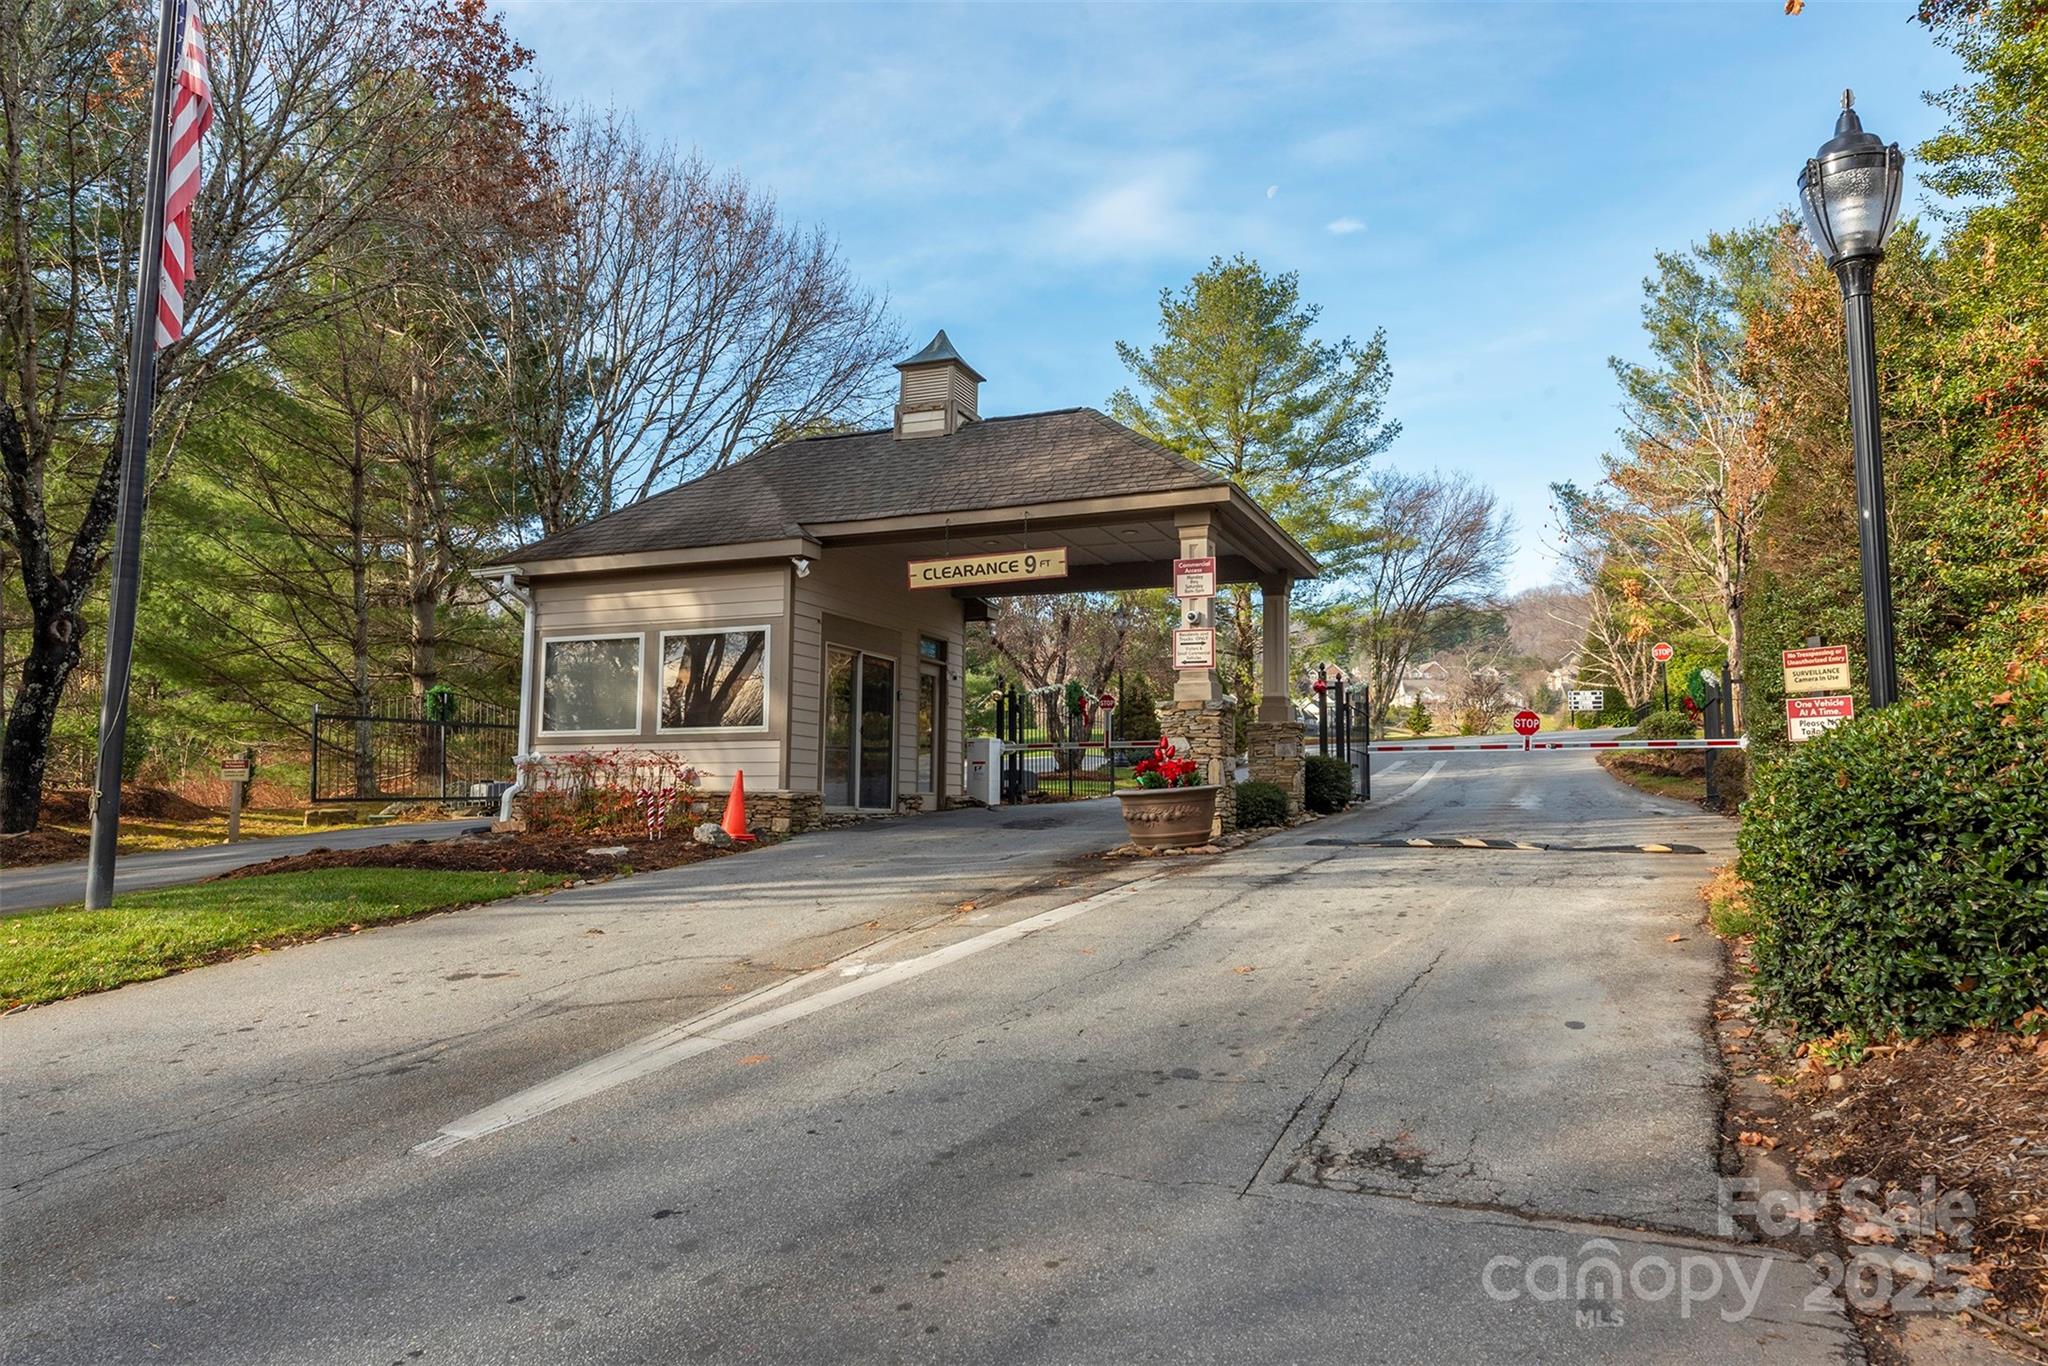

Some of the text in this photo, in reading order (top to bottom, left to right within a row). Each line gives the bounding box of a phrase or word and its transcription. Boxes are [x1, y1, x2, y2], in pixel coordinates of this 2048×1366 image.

[923, 555, 1051, 580] CLEARANCE 9 FT
[1652, 648, 1672, 656] STOP
[1792, 668, 1840, 676] SURVEILLANCE
[1794, 699, 1845, 709] One Vehicle
[1799, 707, 1842, 717] At A Time.
[1514, 718, 1540, 728] STOP
[1799, 719, 1825, 727] Please
